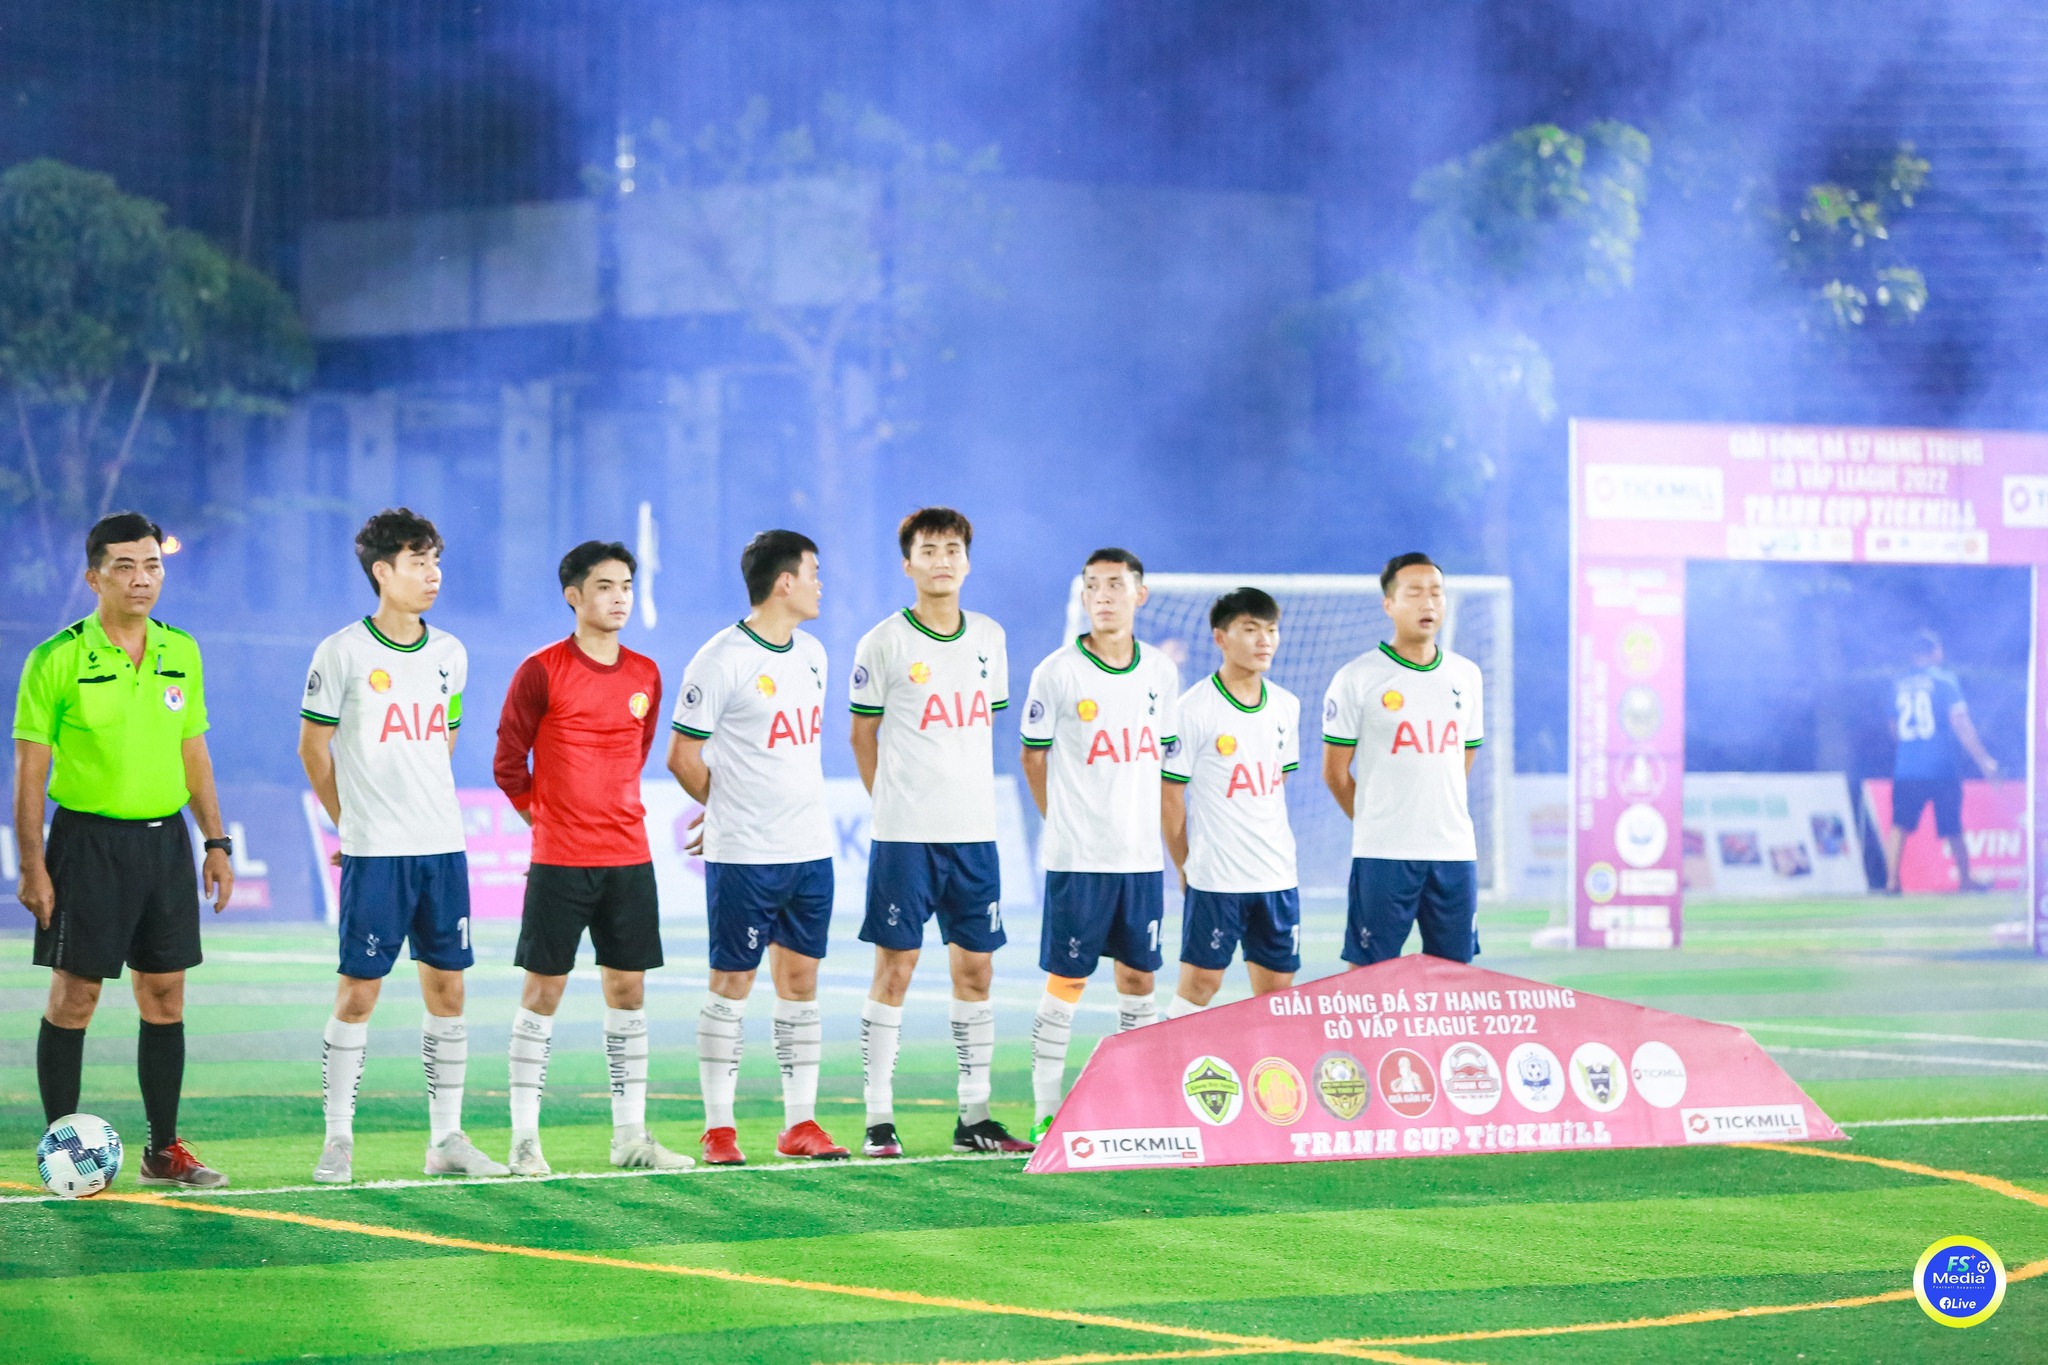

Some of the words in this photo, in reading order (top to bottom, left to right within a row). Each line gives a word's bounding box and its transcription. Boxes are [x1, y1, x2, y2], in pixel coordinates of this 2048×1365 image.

[380, 703, 448, 742] AIA
[919, 690, 991, 730] AIA
[1087, 726, 1159, 765] AIA
[1391, 719, 1459, 755] AIA
[1269, 990, 1313, 1016] GIẢI
[1318, 990, 1378, 1015] BÓNG
[1382, 988, 1411, 1013] ĐÁ
[1414, 991, 1439, 1013] S7
[1444, 990, 1503, 1015] HẠNG
[1506, 988, 1577, 1010] TRUNG
[1324, 1015, 1354, 1039] GÒ
[1357, 1011, 1399, 1038] VẤP
[1403, 1015, 1480, 1037] LEAGUE
[1483, 1014, 1538, 1035] 2022
[1714, 1113, 1801, 1129] TICKMILL
[1100, 1136, 1197, 1153] TICKMILL
[1290, 1128, 1398, 1157] TRANH
[1403, 1126, 1460, 1152] CUP
